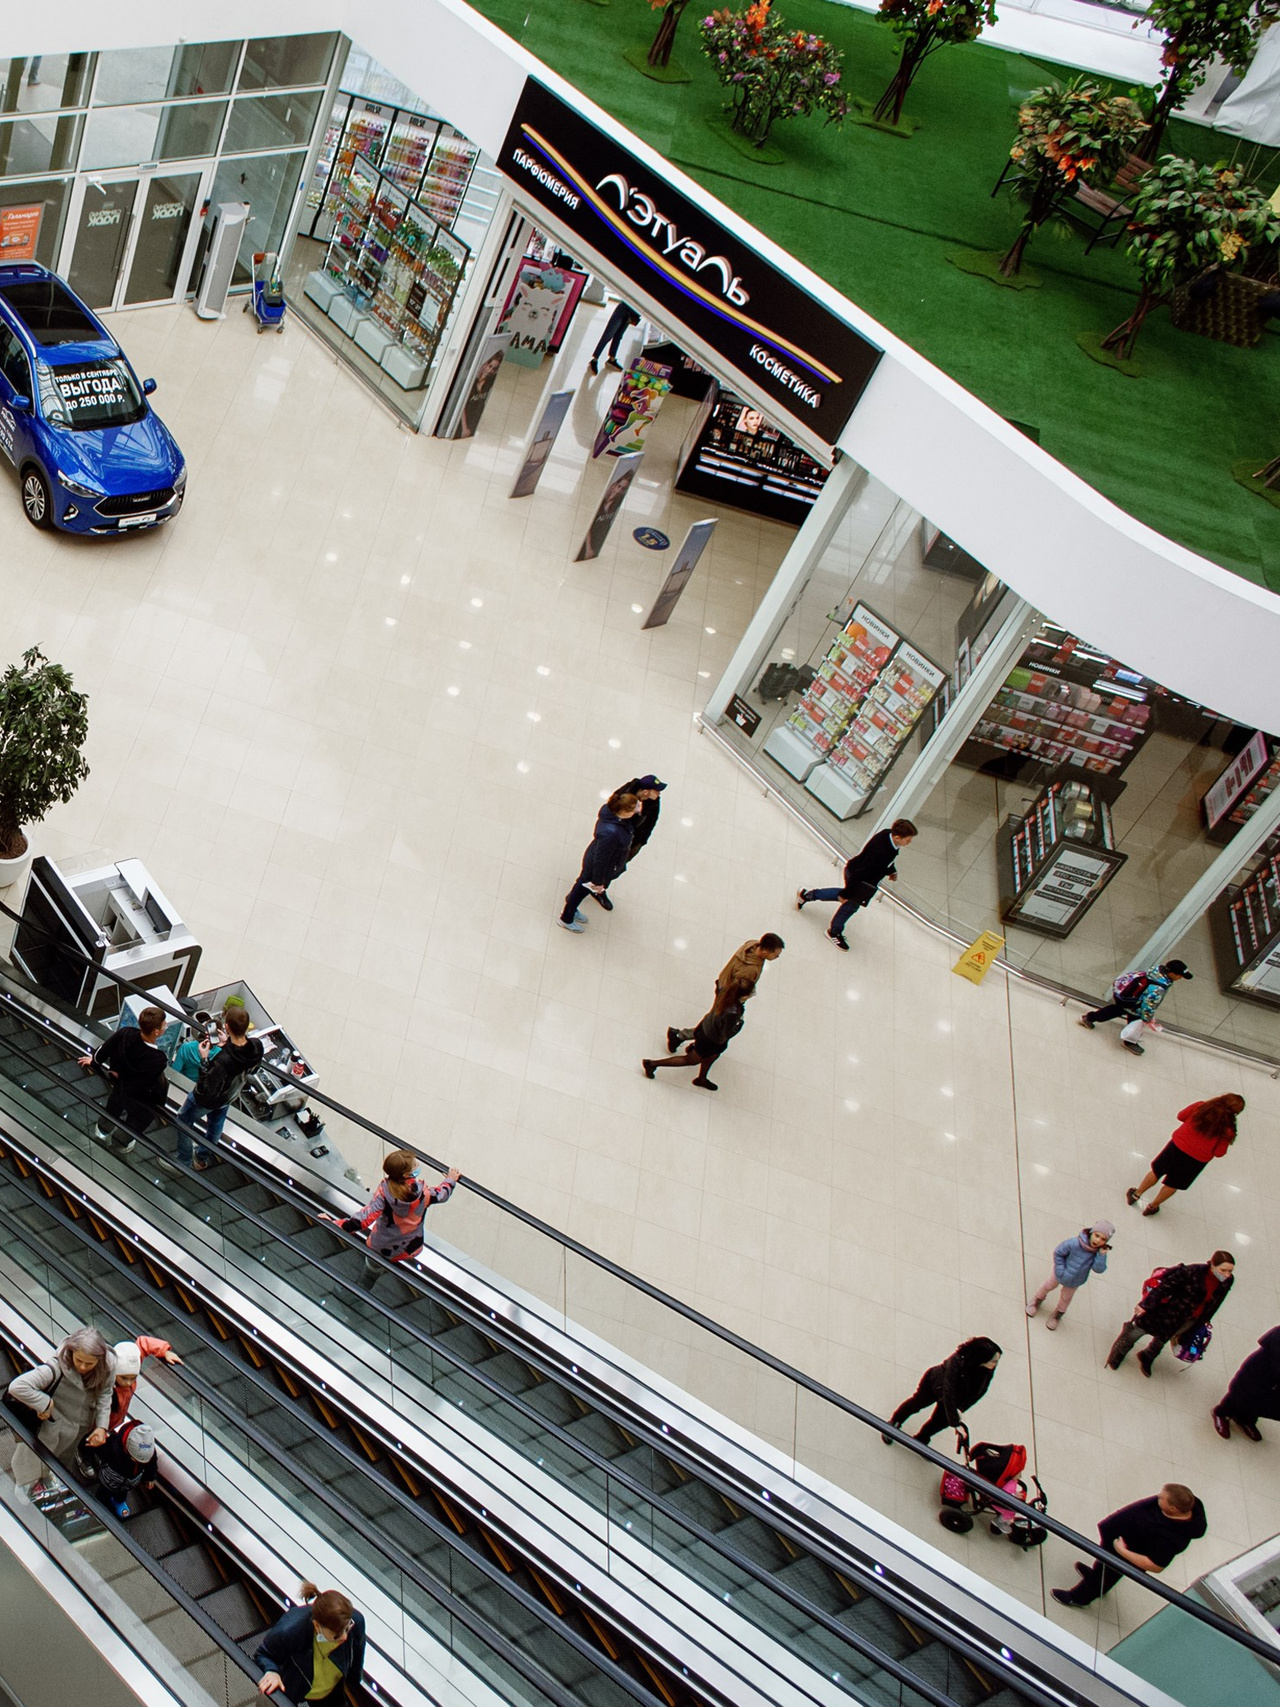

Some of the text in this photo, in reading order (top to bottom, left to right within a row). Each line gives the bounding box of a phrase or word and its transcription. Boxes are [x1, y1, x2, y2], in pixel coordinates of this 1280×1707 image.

[512, 148, 581, 211] ПАРФЮМЕРИЯ
[55, 373, 80, 383] ТОЛЬКО
[86, 369, 118, 379] СЕНТЯБРЕ
[59, 377, 122, 398] ВЫГОДА
[748, 343, 821, 410] КОСМЕТИКА
[78, 395, 98, 408] 250
[98, 393, 116, 405] 000
[861, 613, 890, 640] НОВИНКИ
[906, 651, 936, 678] НОВИНКИ
[1028, 661, 1061, 675] НОВИНКИ
